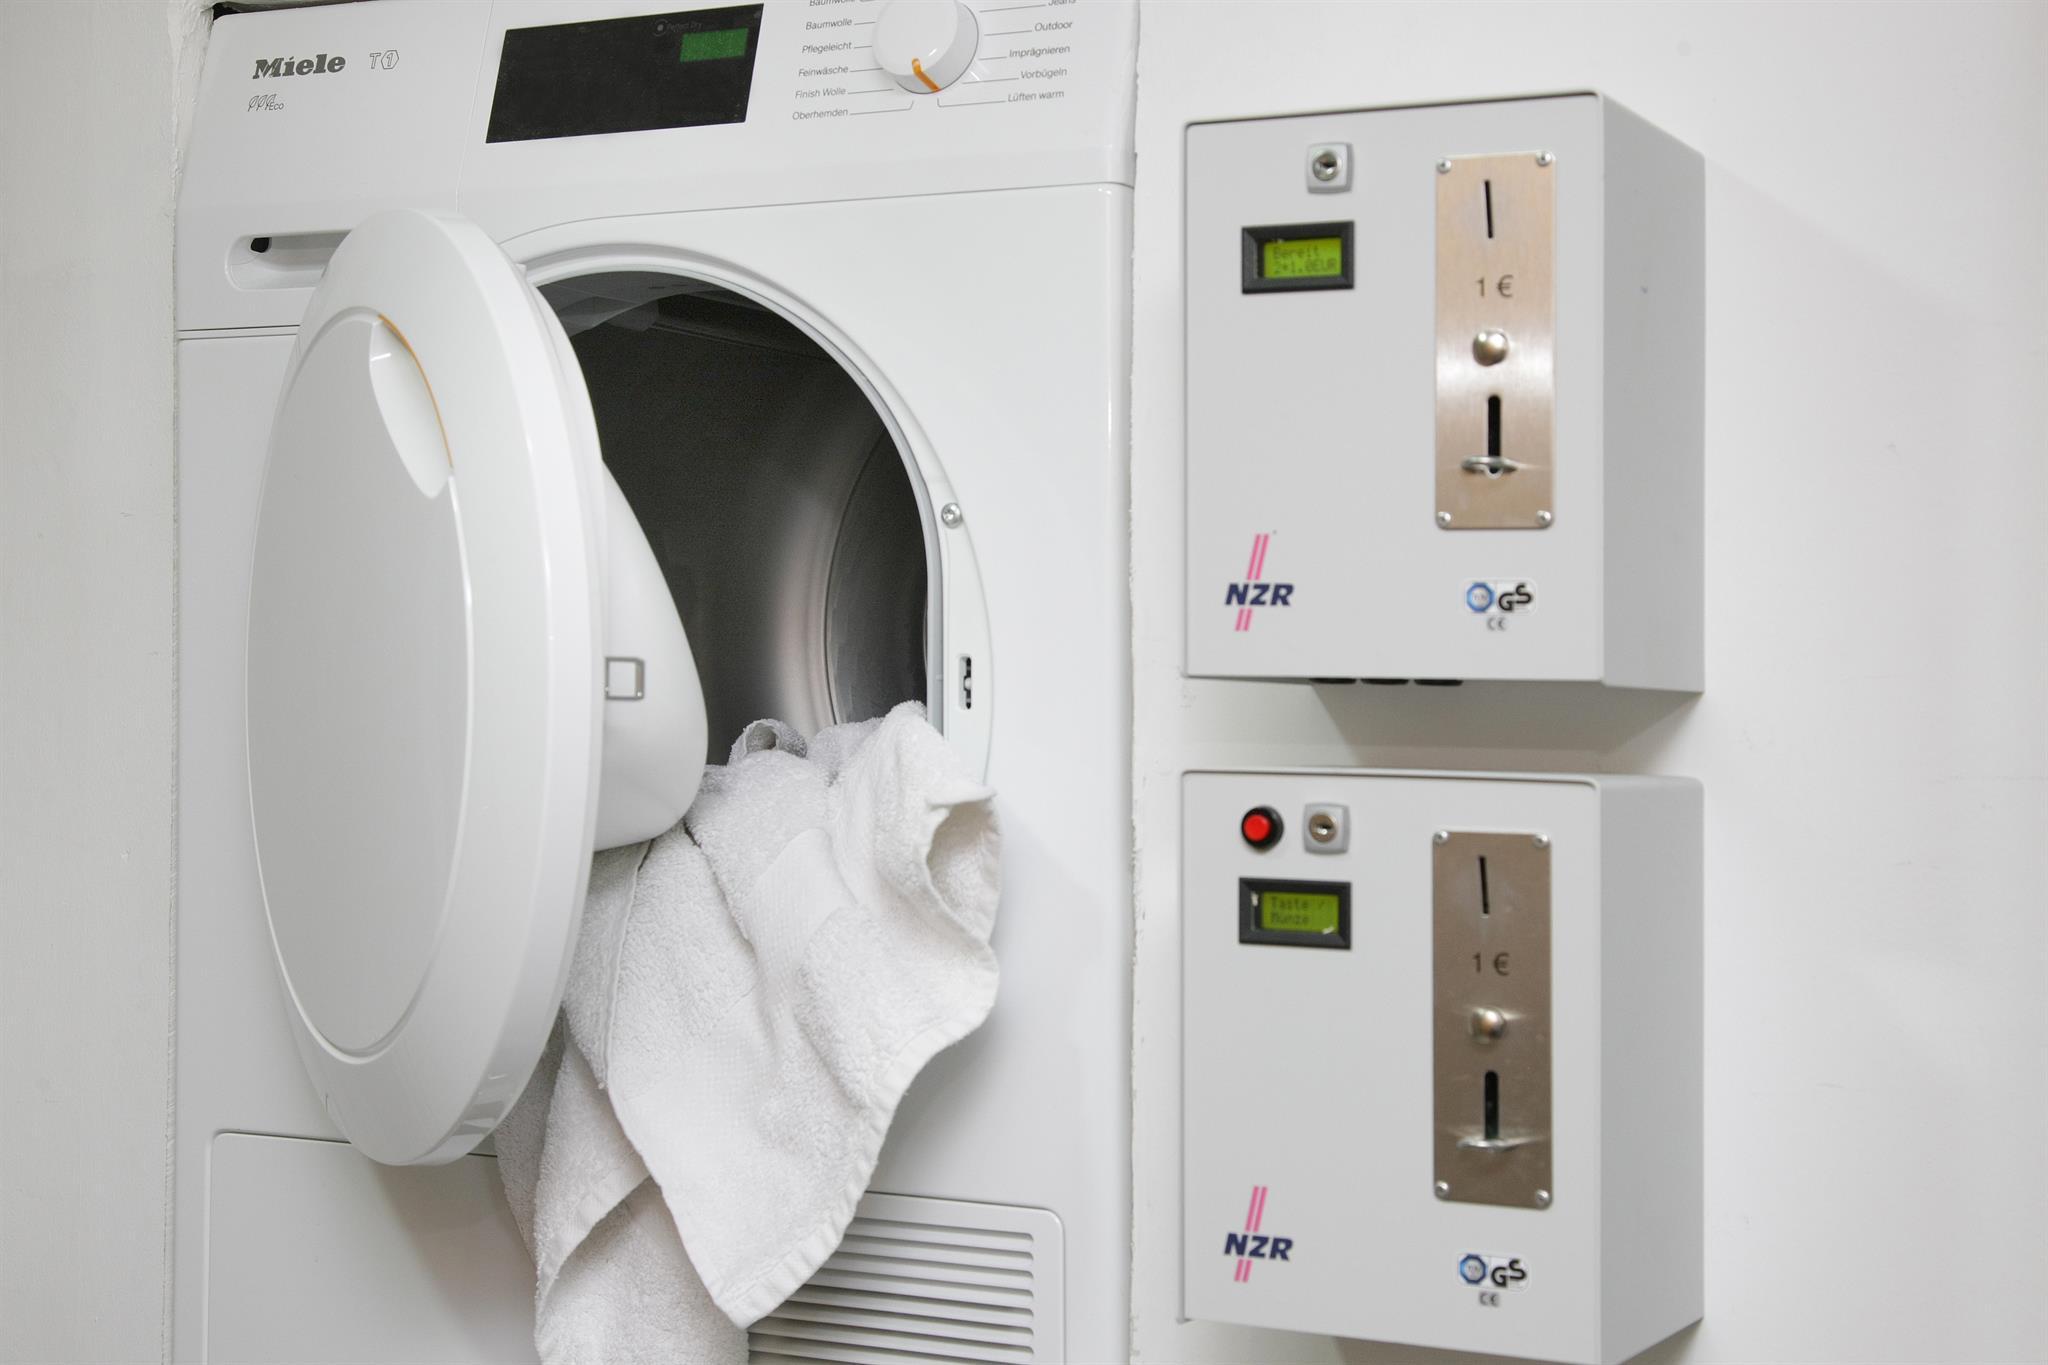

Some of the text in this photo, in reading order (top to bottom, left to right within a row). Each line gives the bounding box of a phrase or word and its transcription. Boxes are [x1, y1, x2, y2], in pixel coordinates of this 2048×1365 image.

[805, 18, 853, 30] Baumwolle
[1034, 20, 1073, 32] Outdoor
[801, 41, 853, 54] Pflegeleicht
[1008, 45, 1071, 59] Imprägnieren
[252, 53, 346, 80] Miele
[798, 65, 849, 77] Feinwäsche
[1020, 67, 1068, 80] Vorbügeln
[794, 87, 847, 99] Finish Wolle
[1007, 90, 1065, 103] Lüften warm
[791, 108, 849, 121] Oberhemden
[1476, 274, 1514, 299] 1 €
[1225, 583, 1294, 606] NZR
[1498, 583, 1533, 613] GS
[1472, 951, 1511, 977] 1 €
[1224, 1233, 1293, 1261] NZR
[1491, 1259, 1527, 1288] GS
